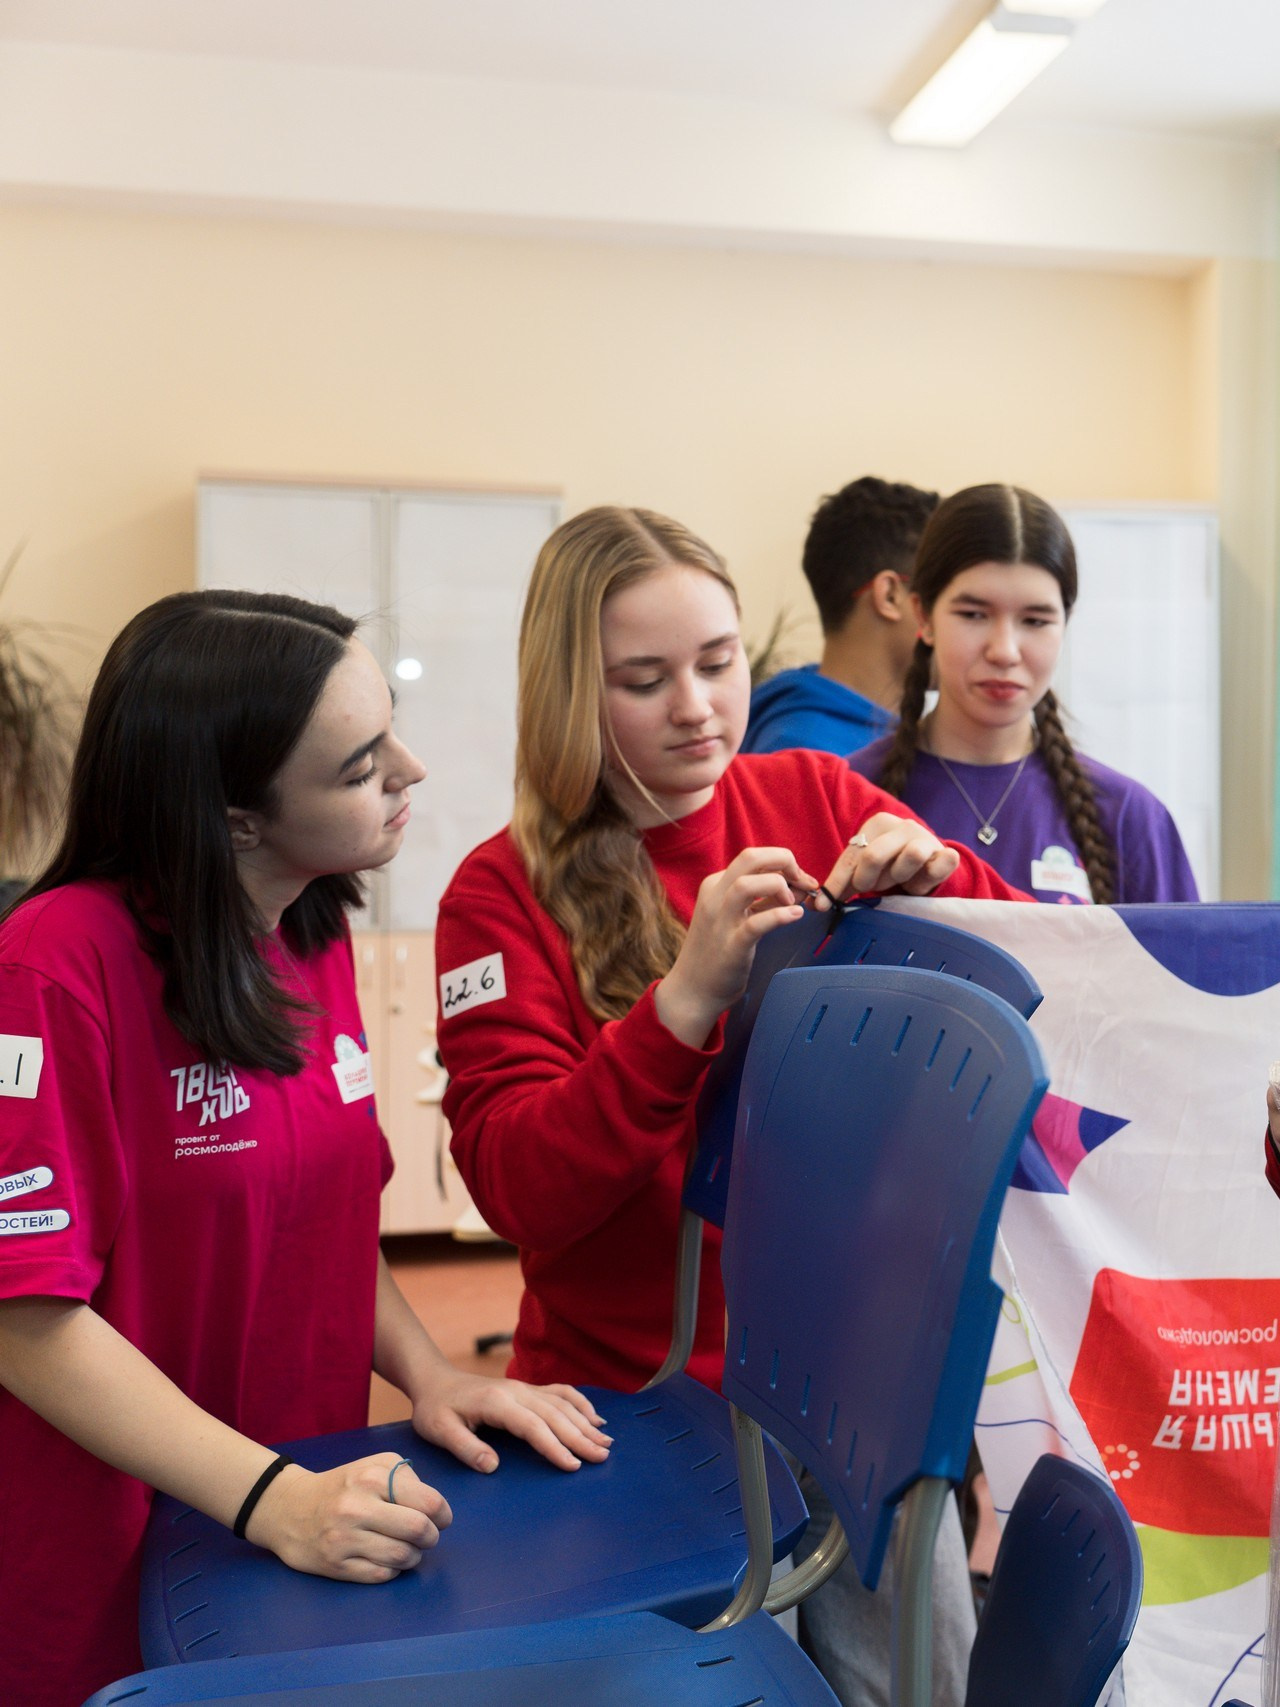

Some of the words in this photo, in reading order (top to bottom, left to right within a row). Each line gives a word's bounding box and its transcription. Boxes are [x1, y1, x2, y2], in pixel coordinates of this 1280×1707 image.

[445, 965, 495, 1008] 22.6
[174, 1135, 208, 1146] проект
[209, 1134, 221, 1142] от
